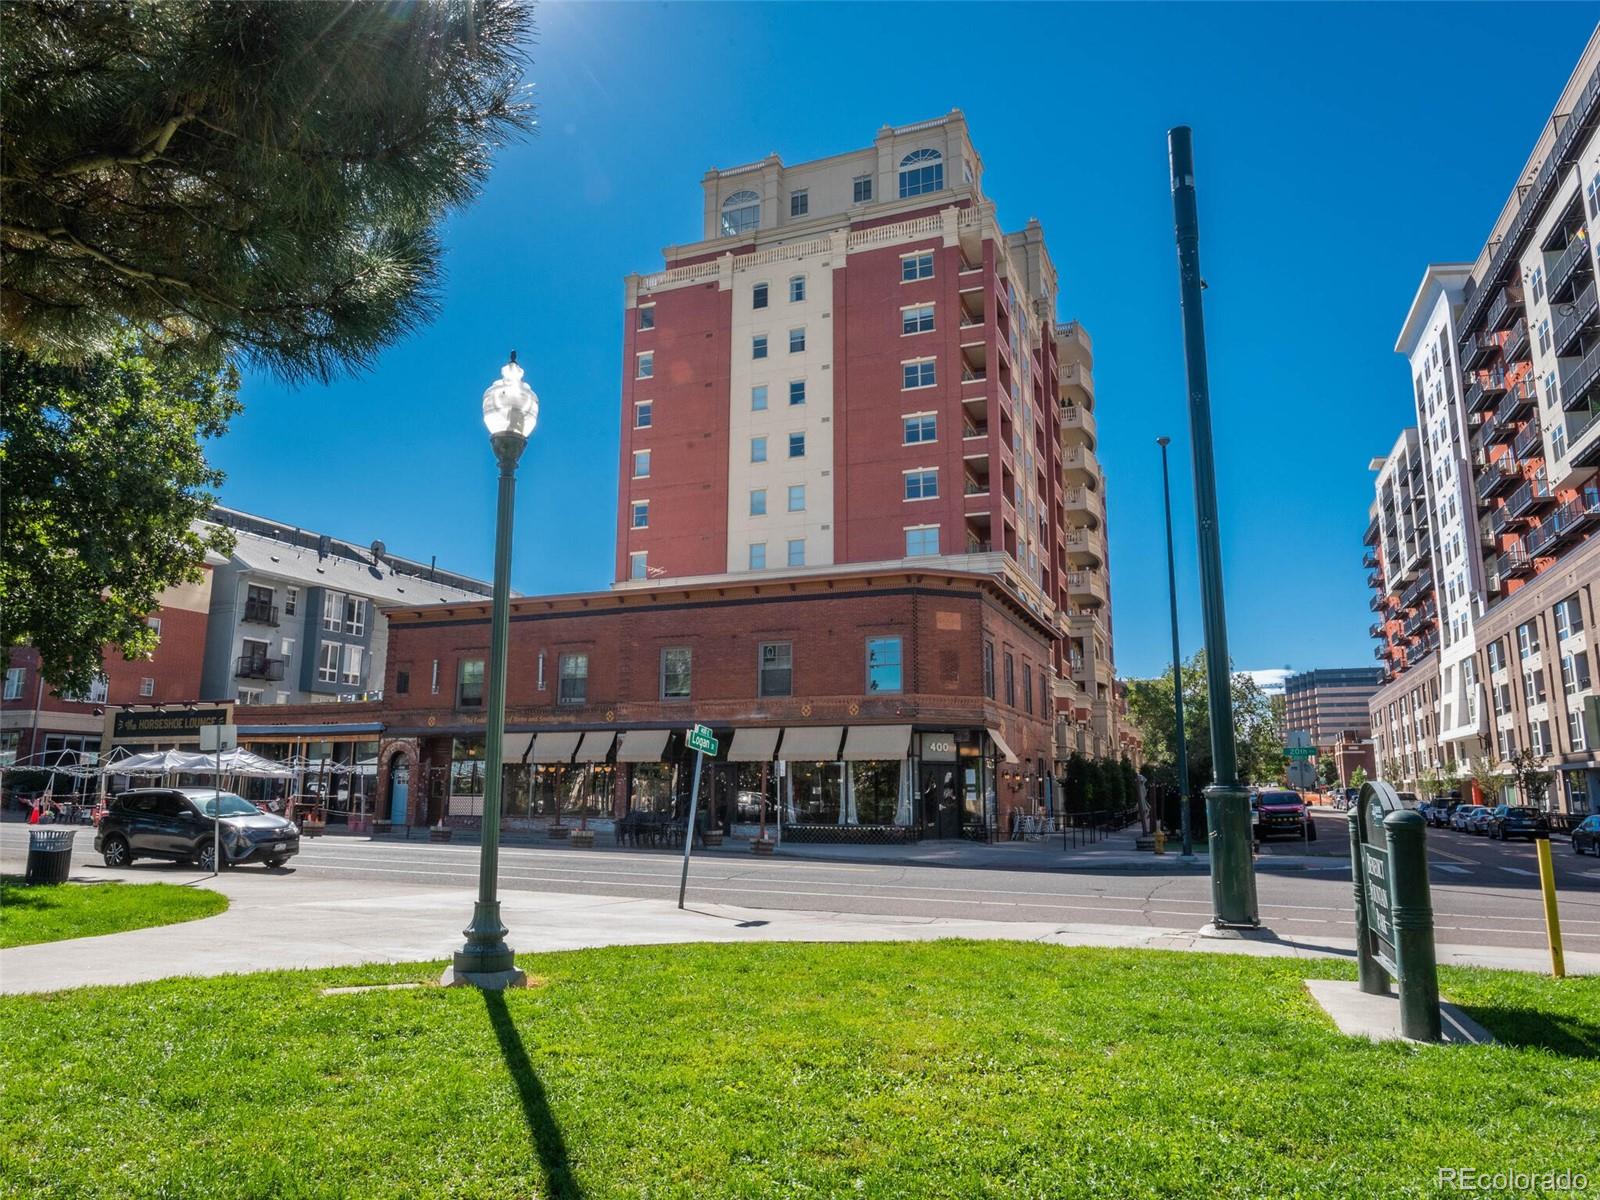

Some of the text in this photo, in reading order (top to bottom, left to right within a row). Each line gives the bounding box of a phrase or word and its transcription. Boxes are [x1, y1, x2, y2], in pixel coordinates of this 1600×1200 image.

[138, 718, 183, 730] HORSESHOE
[184, 716, 216, 729] LOUNGE
[692, 732, 710, 750] Logan
[930, 743, 949, 752] 400
